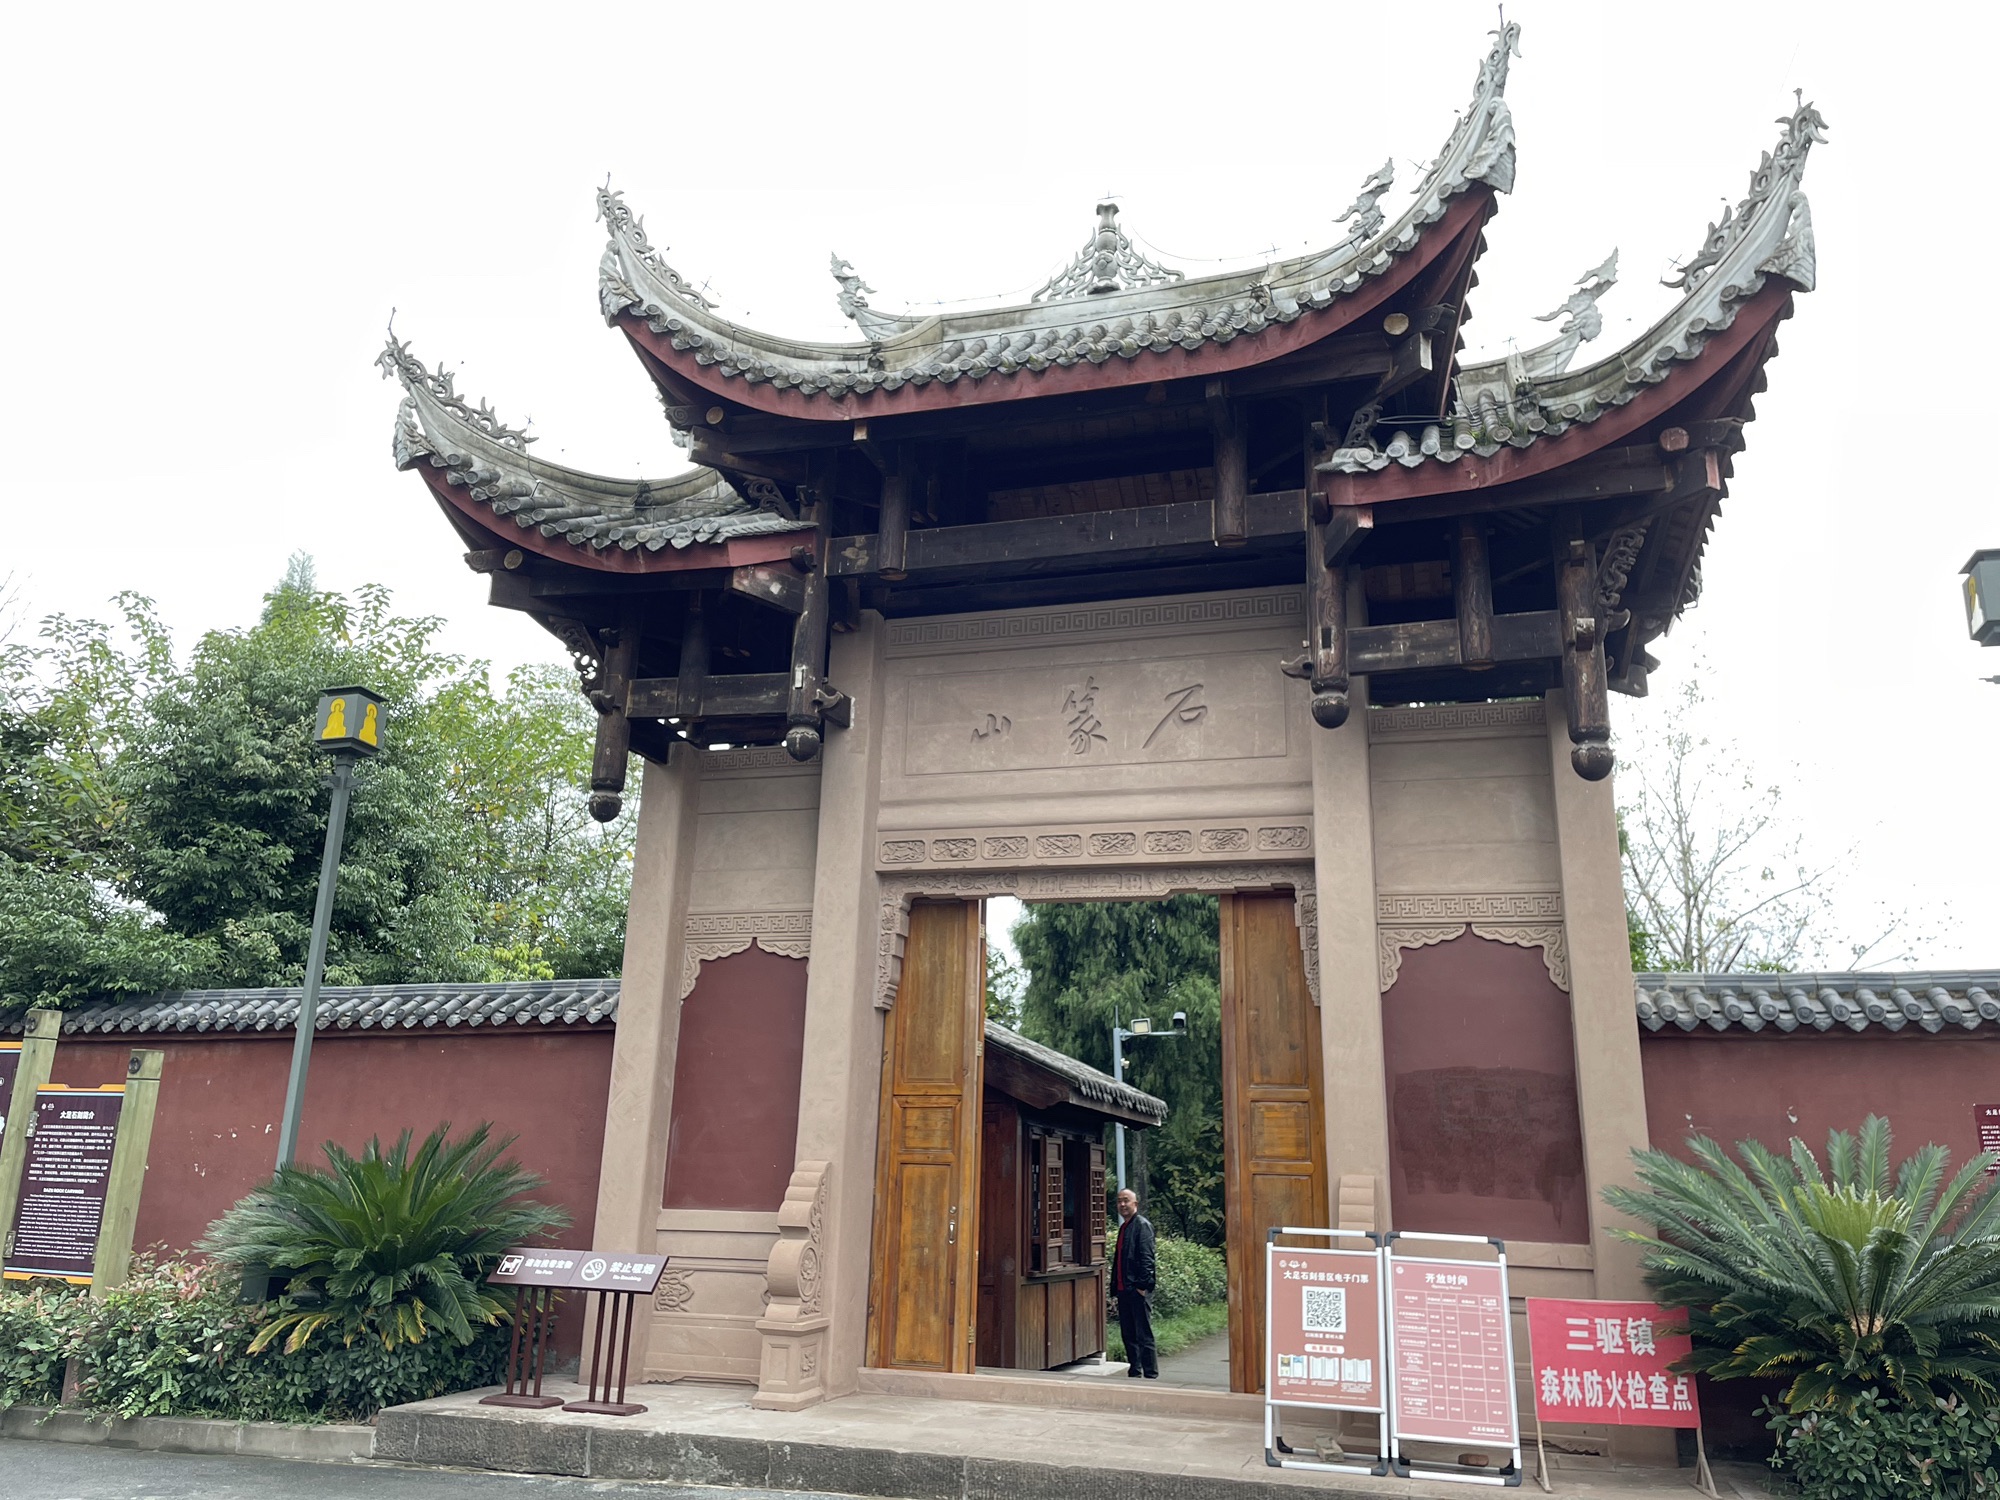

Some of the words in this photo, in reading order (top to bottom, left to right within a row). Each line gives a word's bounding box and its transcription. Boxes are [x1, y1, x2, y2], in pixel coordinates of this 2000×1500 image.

[609, 1261, 656, 1275] 禁止吸烟
[1283, 1270, 1369, 1283] 大足石刻景区电子门票
[1425, 1273, 1468, 1286] 开放时间
[1566, 1317, 1656, 1356] 三驱镇
[1541, 1366, 1693, 1411] 森林防火检查点
